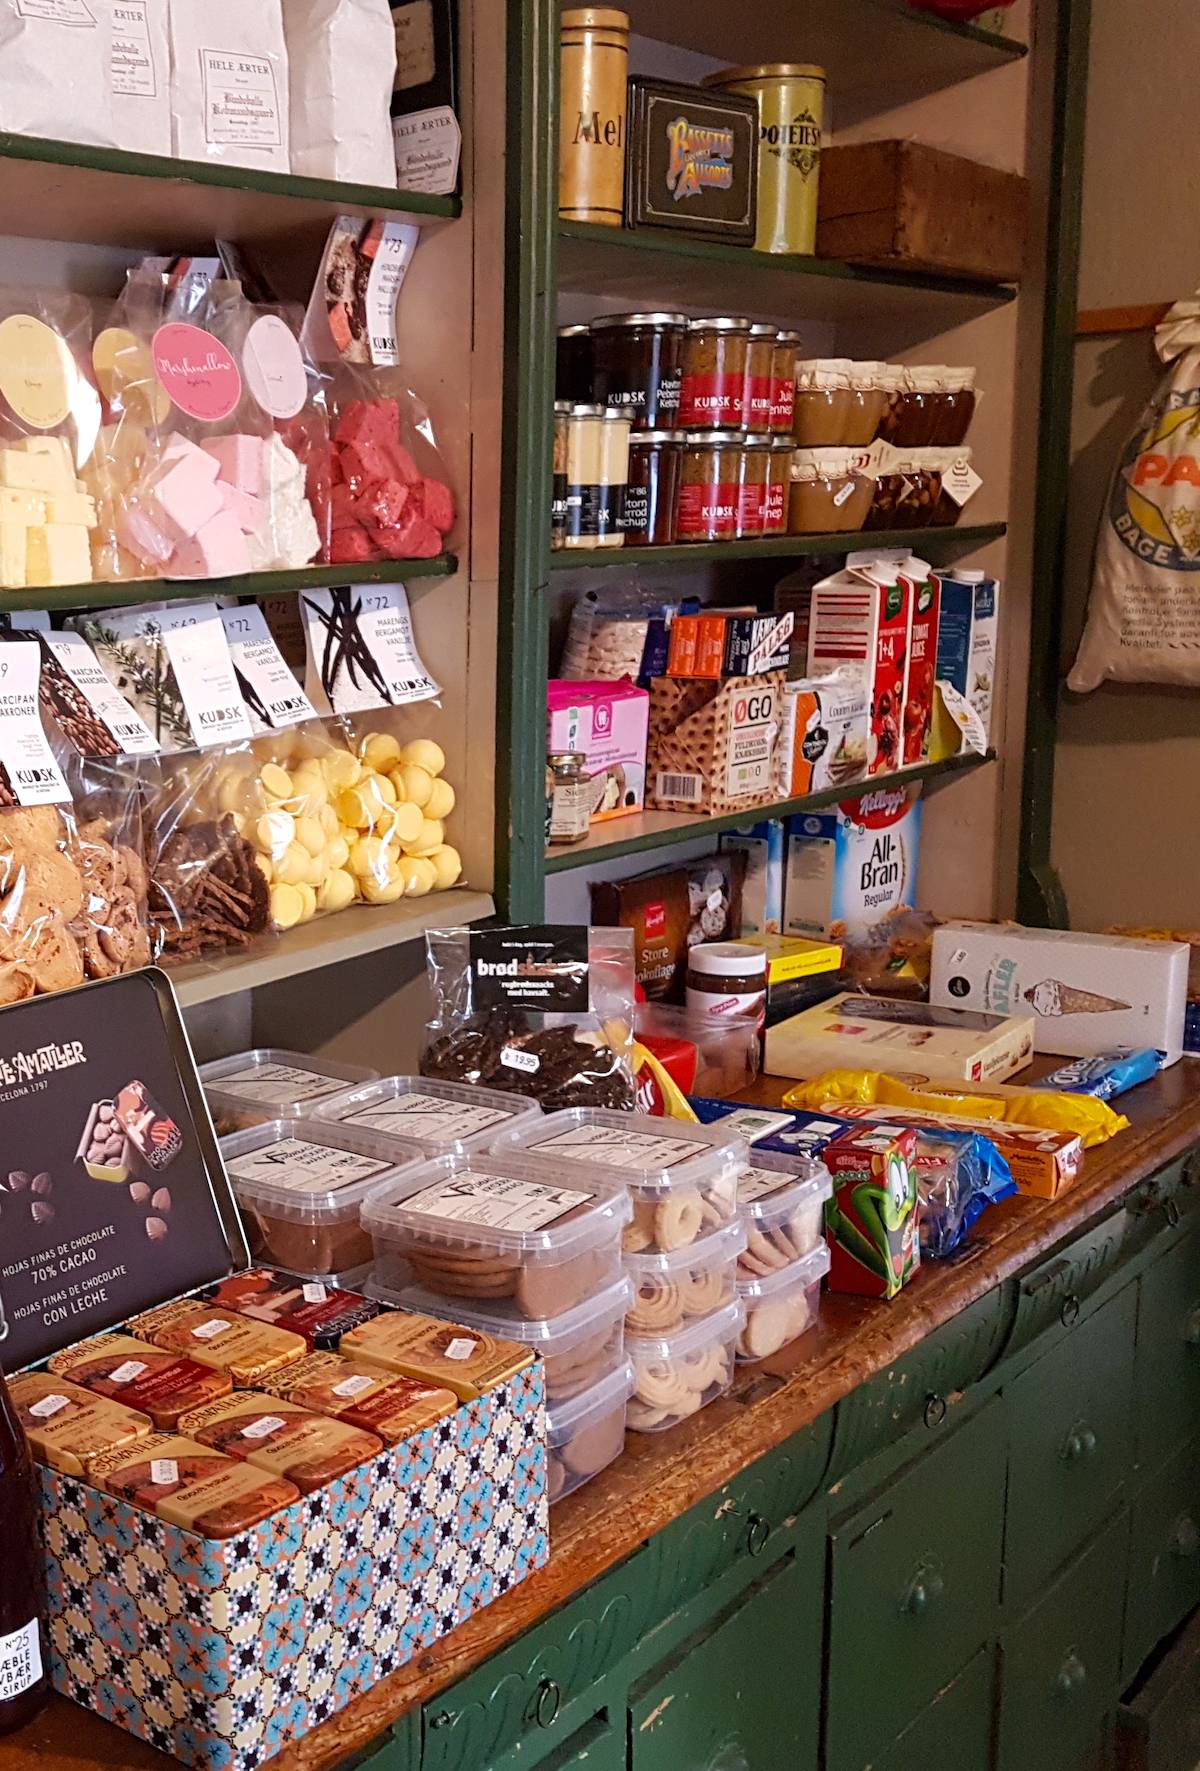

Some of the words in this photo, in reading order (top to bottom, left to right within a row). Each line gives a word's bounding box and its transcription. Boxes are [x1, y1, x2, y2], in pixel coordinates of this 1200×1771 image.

[209, 60, 235, 71] HELE
[237, 63, 270, 75] ÆRTER
[420, 116, 452, 131] ÆRTER
[572, 111, 622, 148] Mel
[608, 390, 646, 405] KUDSK
[694, 396, 731, 409] KUDSK
[751, 398, 771, 409] KUDS
[769, 403, 793, 415] ennep
[1133, 454, 1200, 487] PA
[702, 506, 734, 518] KUDSK
[1115, 511, 1173, 564] BAGE
[391, 677, 432, 692] KUDSK
[270, 696, 307, 714] KUDSK
[734, 695, 772, 724] ØGO
[200, 706, 243, 725] KUDSK
[113, 723, 146, 735] KUDSK
[16, 768, 58, 784] KUDSK
[860, 862, 898, 890] Bran
[864, 890, 894, 908] Regular
[642, 946, 669, 963] Store
[513, 1051, 537, 1068] 19.95
[30, 1079, 49, 1095] 1797
[1, 1260, 29, 1278] HOJAS
[31, 1249, 56, 1269] FINAS
[57, 1243, 69, 1257] DE
[70, 1224, 116, 1251] CHOCOLATE
[31, 1264, 57, 1286] 70%
[59, 1248, 98, 1275] CACAO
[13, 1300, 41, 1320] HOJAS
[42, 1289, 68, 1309] FINAS
[68, 1284, 81, 1297] DE
[81, 1264, 127, 1290] CHOCOLATE
[43, 1306, 69, 1328] CON
[71, 1288, 108, 1315] LECHE
[0, 1648, 31, 1674] ÆBLE
[2, 1674, 33, 1697] SIRUP
